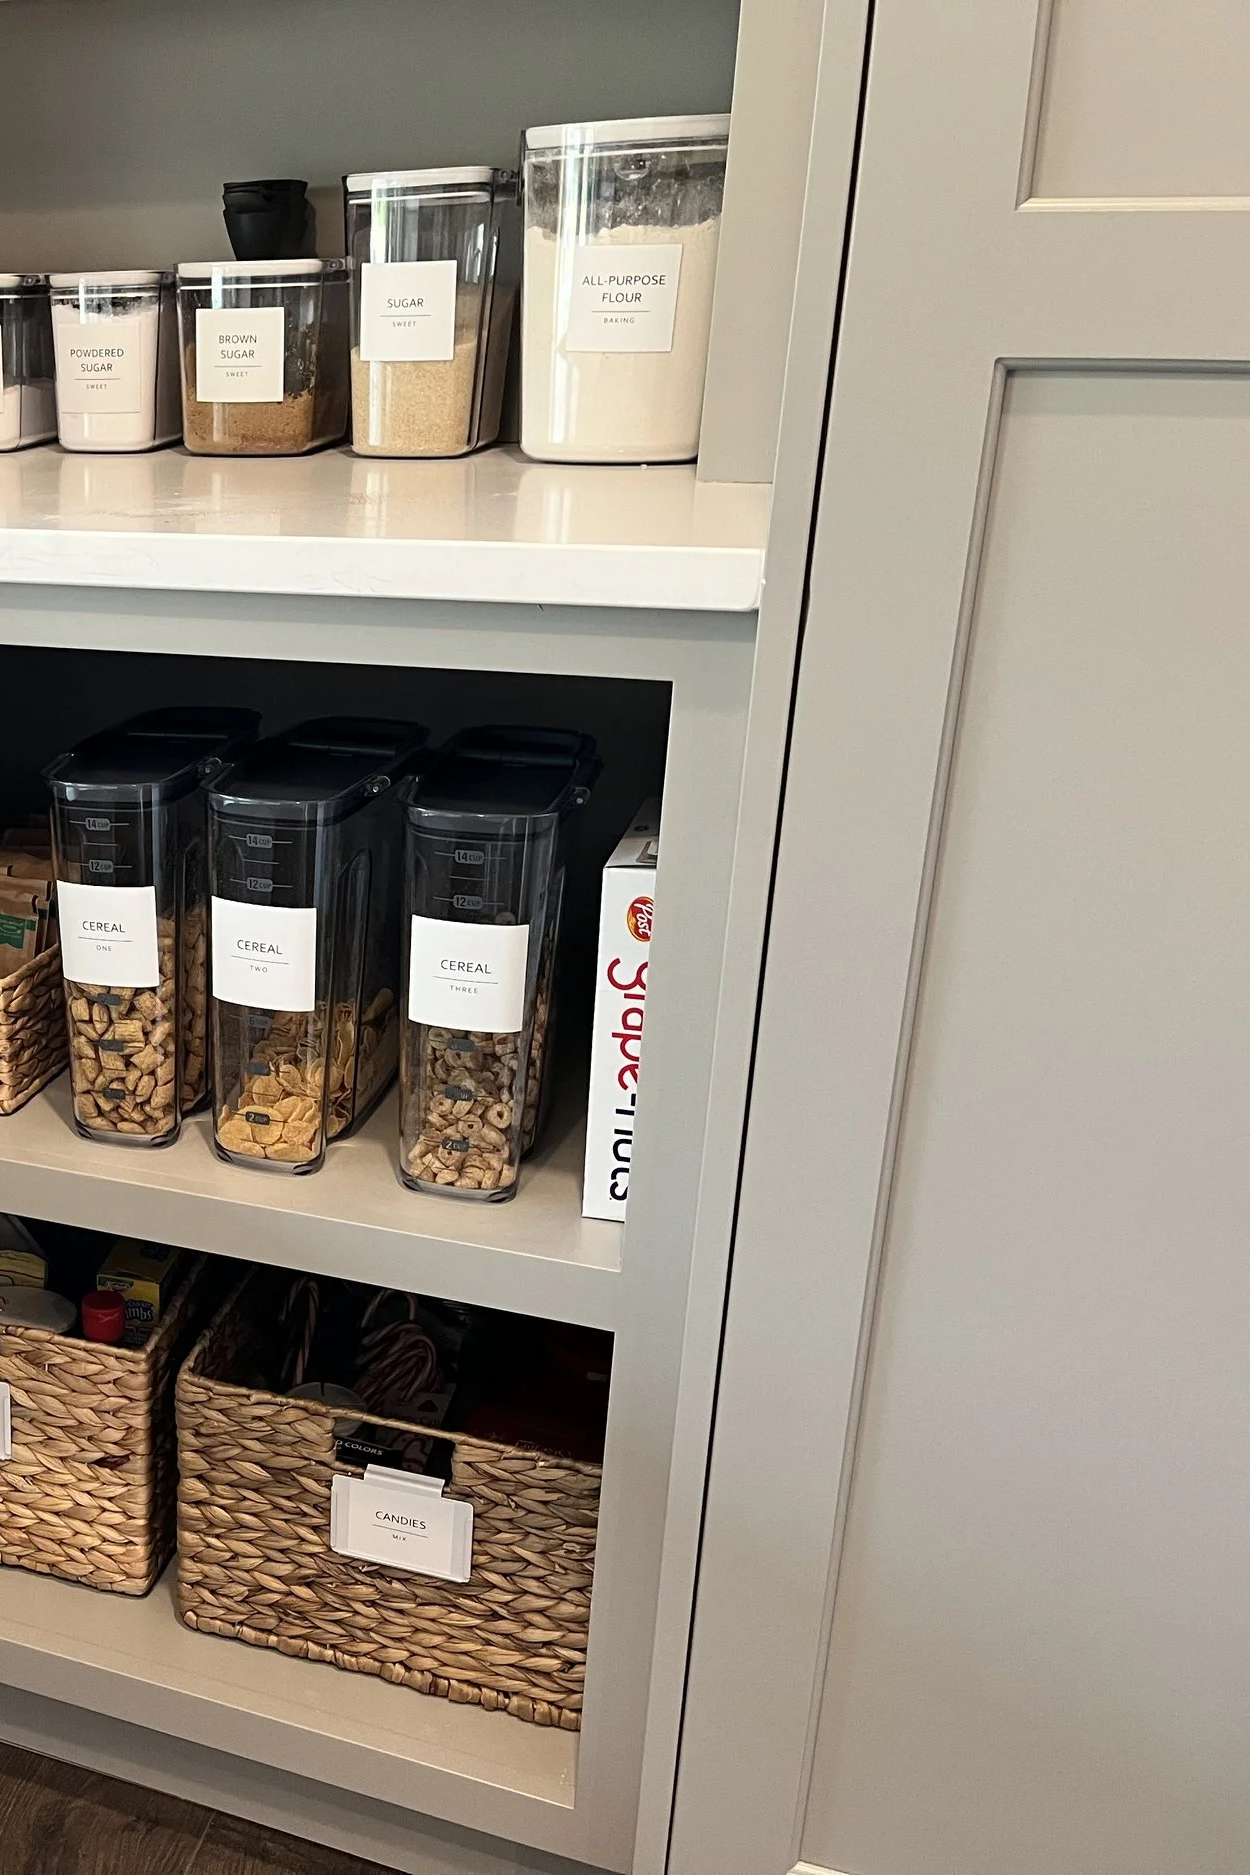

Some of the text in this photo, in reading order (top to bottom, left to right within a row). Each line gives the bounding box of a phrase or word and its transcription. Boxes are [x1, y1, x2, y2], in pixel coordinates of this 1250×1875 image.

[581, 274, 667, 286] ALL-PURPOSE
[601, 292, 642, 303] FLOUR
[387, 298, 424, 308] SUGAR
[218, 334, 258, 344] BROWN
[69, 348, 125, 358] POWDERED
[220, 350, 255, 359] SUGAR
[80, 363, 113, 373] SUGAR
[87, 818, 97, 829] 14
[248, 835, 271, 846] 14 CUP
[457, 852, 468, 862] 14
[90, 861, 100, 871] 12
[248, 879, 258, 889] 12
[455, 896, 466, 907] 12
[82, 920, 126, 933] CEREAL
[236, 939, 283, 955] CEREAL
[250, 965, 268, 973] TWO
[440, 959, 492, 974] CEREAL
[450, 985, 479, 994] THREE
[344, 1441, 384, 1456] COLORS
[375, 1510, 427, 1530] CANDIES
